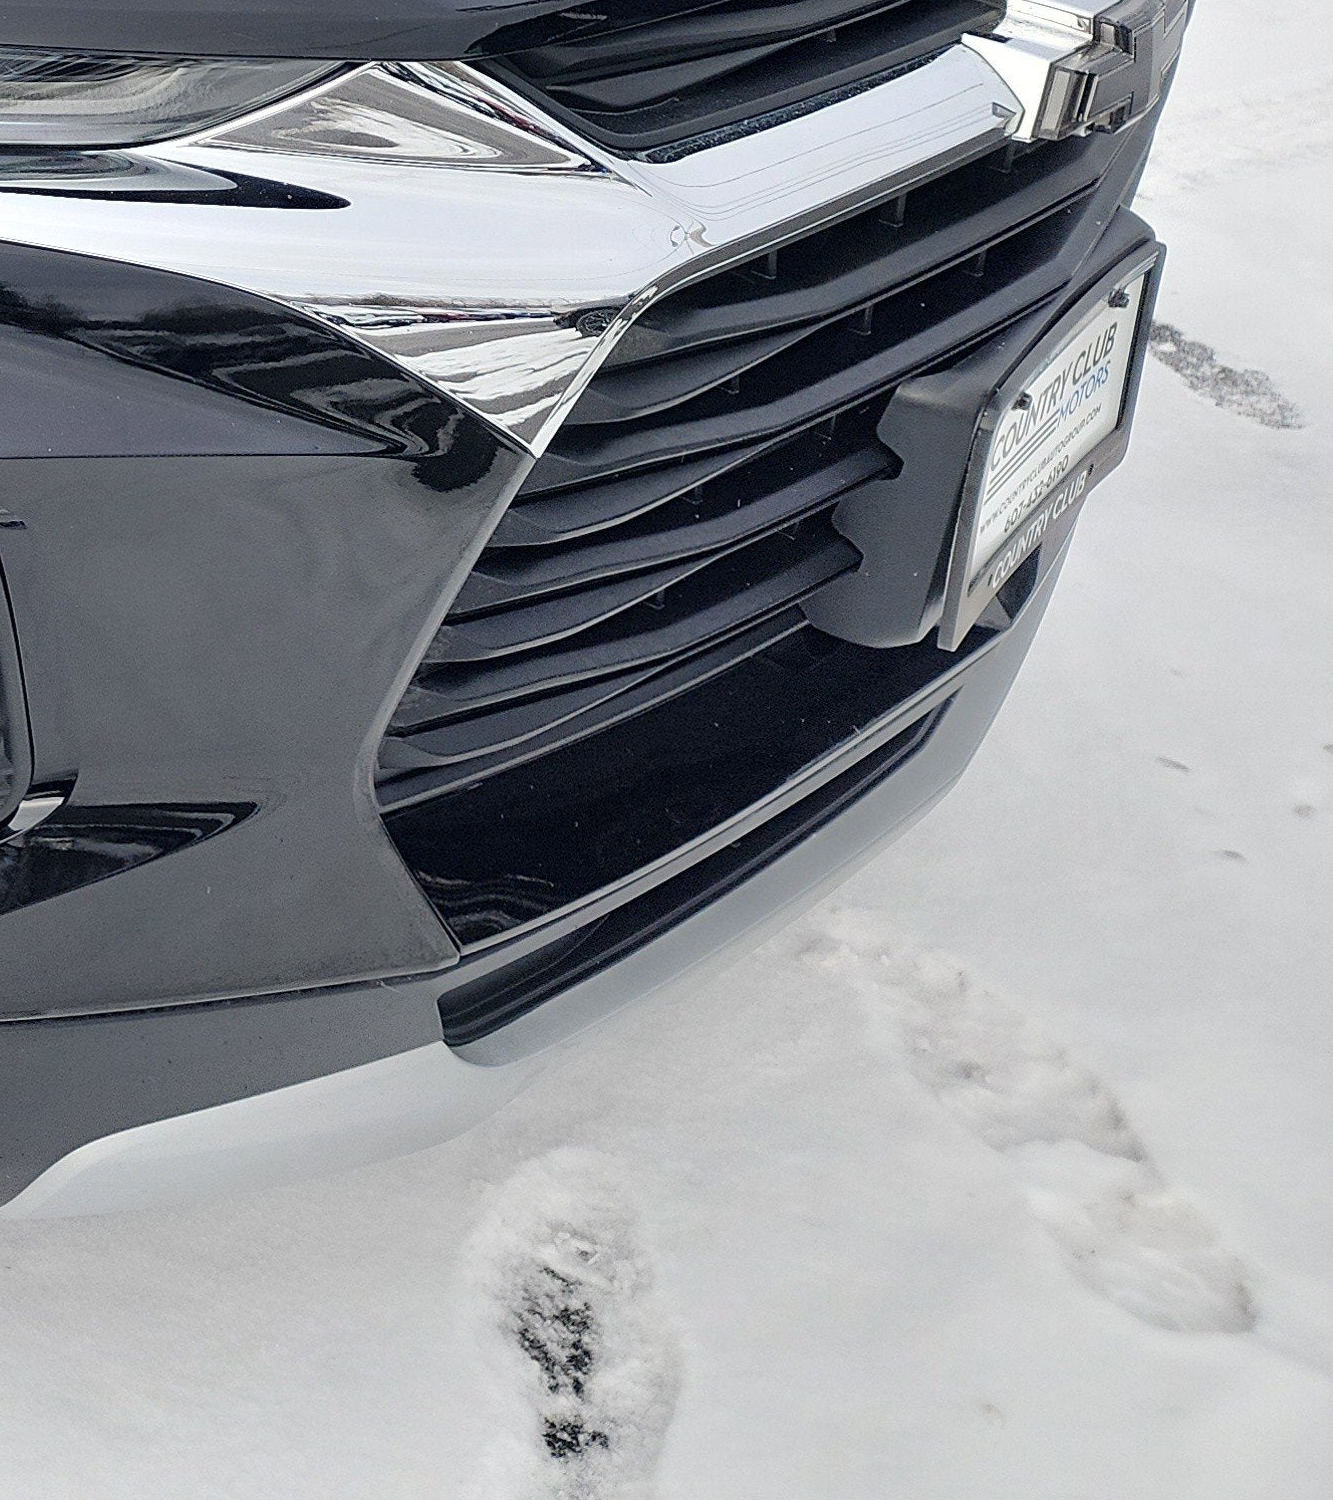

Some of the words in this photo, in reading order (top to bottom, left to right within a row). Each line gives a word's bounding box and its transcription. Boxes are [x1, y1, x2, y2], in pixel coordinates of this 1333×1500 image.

[990, 362, 1073, 472] COUNTRY
[1072, 321, 1118, 386] CLUB
[1057, 360, 1111, 427] MOTORS
[992, 502, 1054, 589] COUNTRY
[1051, 469, 1089, 521] CLUB
